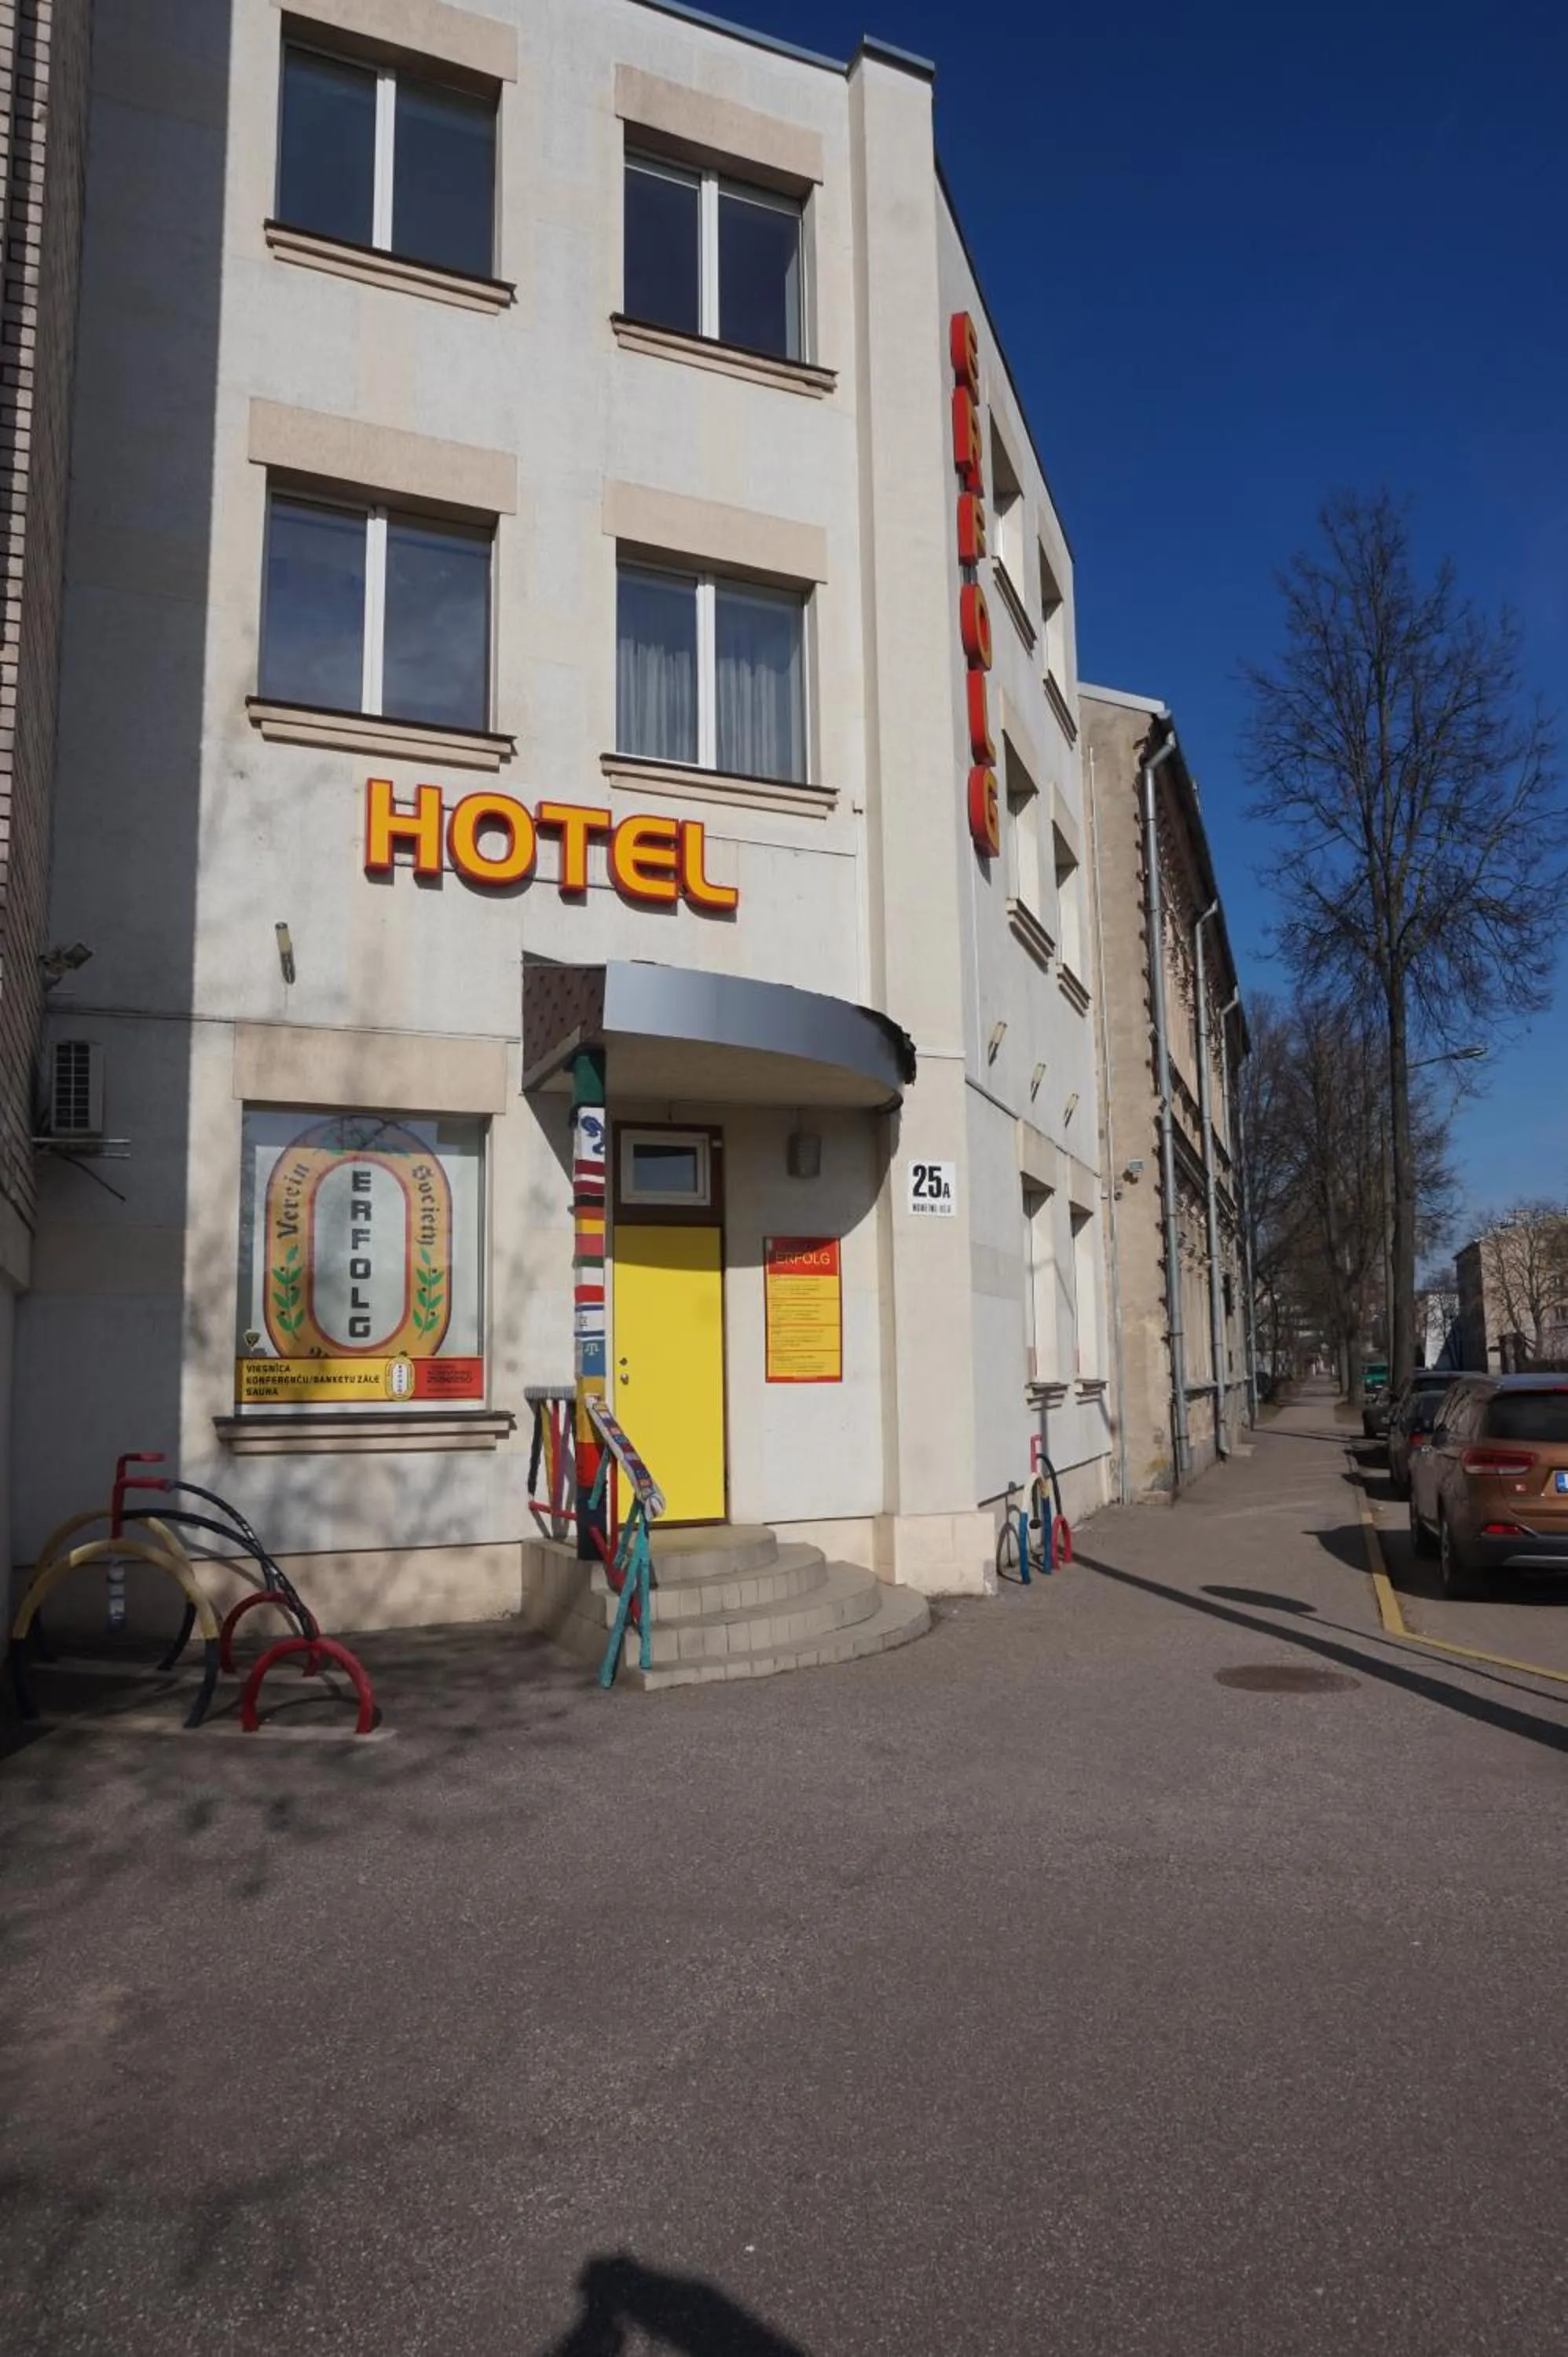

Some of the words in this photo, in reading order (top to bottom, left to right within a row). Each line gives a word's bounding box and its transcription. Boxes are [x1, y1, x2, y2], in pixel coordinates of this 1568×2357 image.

[951, 311, 999, 858] ERFOLG
[365, 778, 738, 912] HOTEL
[912, 1164, 951, 1199] 25A
[348, 1170, 372, 1338] ERFOLG
[775, 1251, 831, 1265] ERFOLG
[246, 1386, 279, 1396] SAUNA
